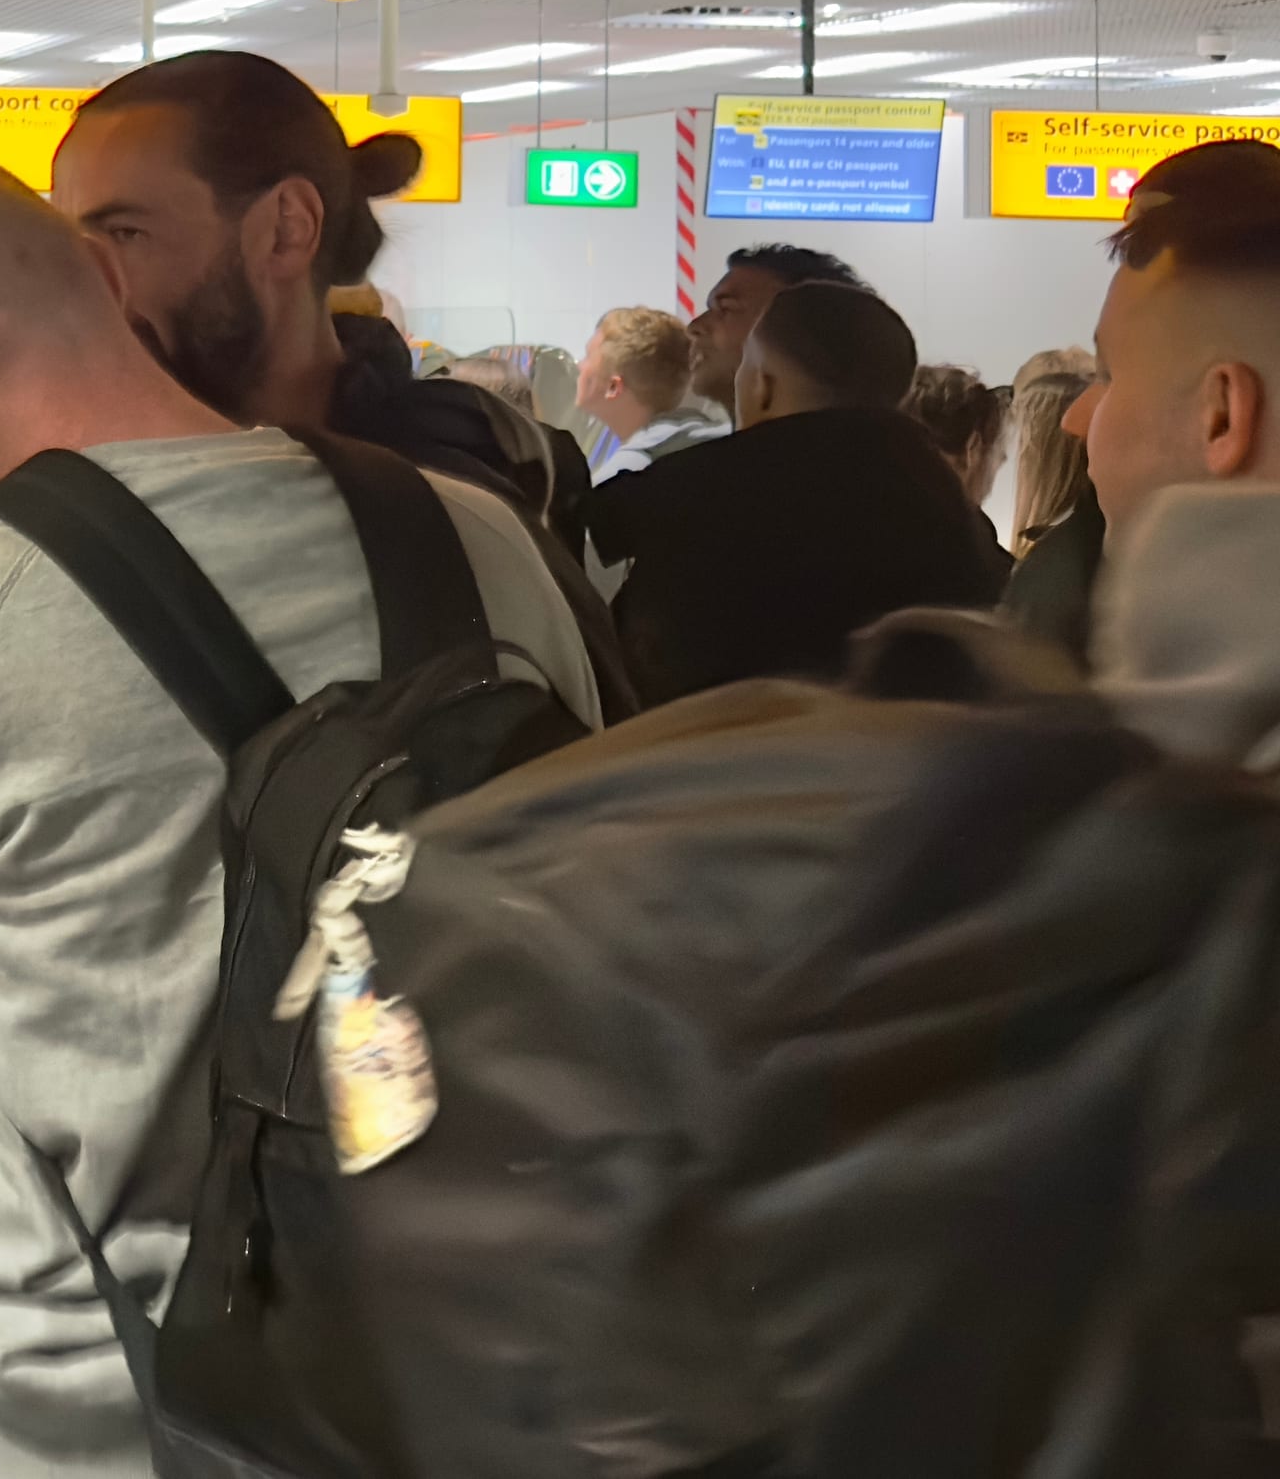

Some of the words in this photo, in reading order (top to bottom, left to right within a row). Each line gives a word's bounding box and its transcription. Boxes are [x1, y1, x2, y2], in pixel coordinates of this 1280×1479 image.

[748, 101, 822, 115] Slf-service
[824, 104, 884, 118] passport
[884, 104, 933, 116] control
[1043, 116, 1186, 139] Self-service
[769, 135, 831, 148] Passengers
[834, 137, 847, 147] 14
[849, 138, 879, 149] years
[881, 138, 904, 148] and
[905, 138, 936, 149] older
[1043, 142, 1068, 154] For
[1073, 144, 1158, 159] passengers
[811, 161, 825, 169] or
[826, 159, 843, 169] CH
[844, 160, 900, 172] passports
[765, 177, 788, 187] and
[790, 178, 805, 187] an
[806, 178, 866, 190] e-passport
[867, 178, 911, 191] symbol
[763, 198, 809, 213] Identity
[810, 200, 841, 212] cards
[842, 201, 863, 213] not
[864, 200, 912, 214] allowed
